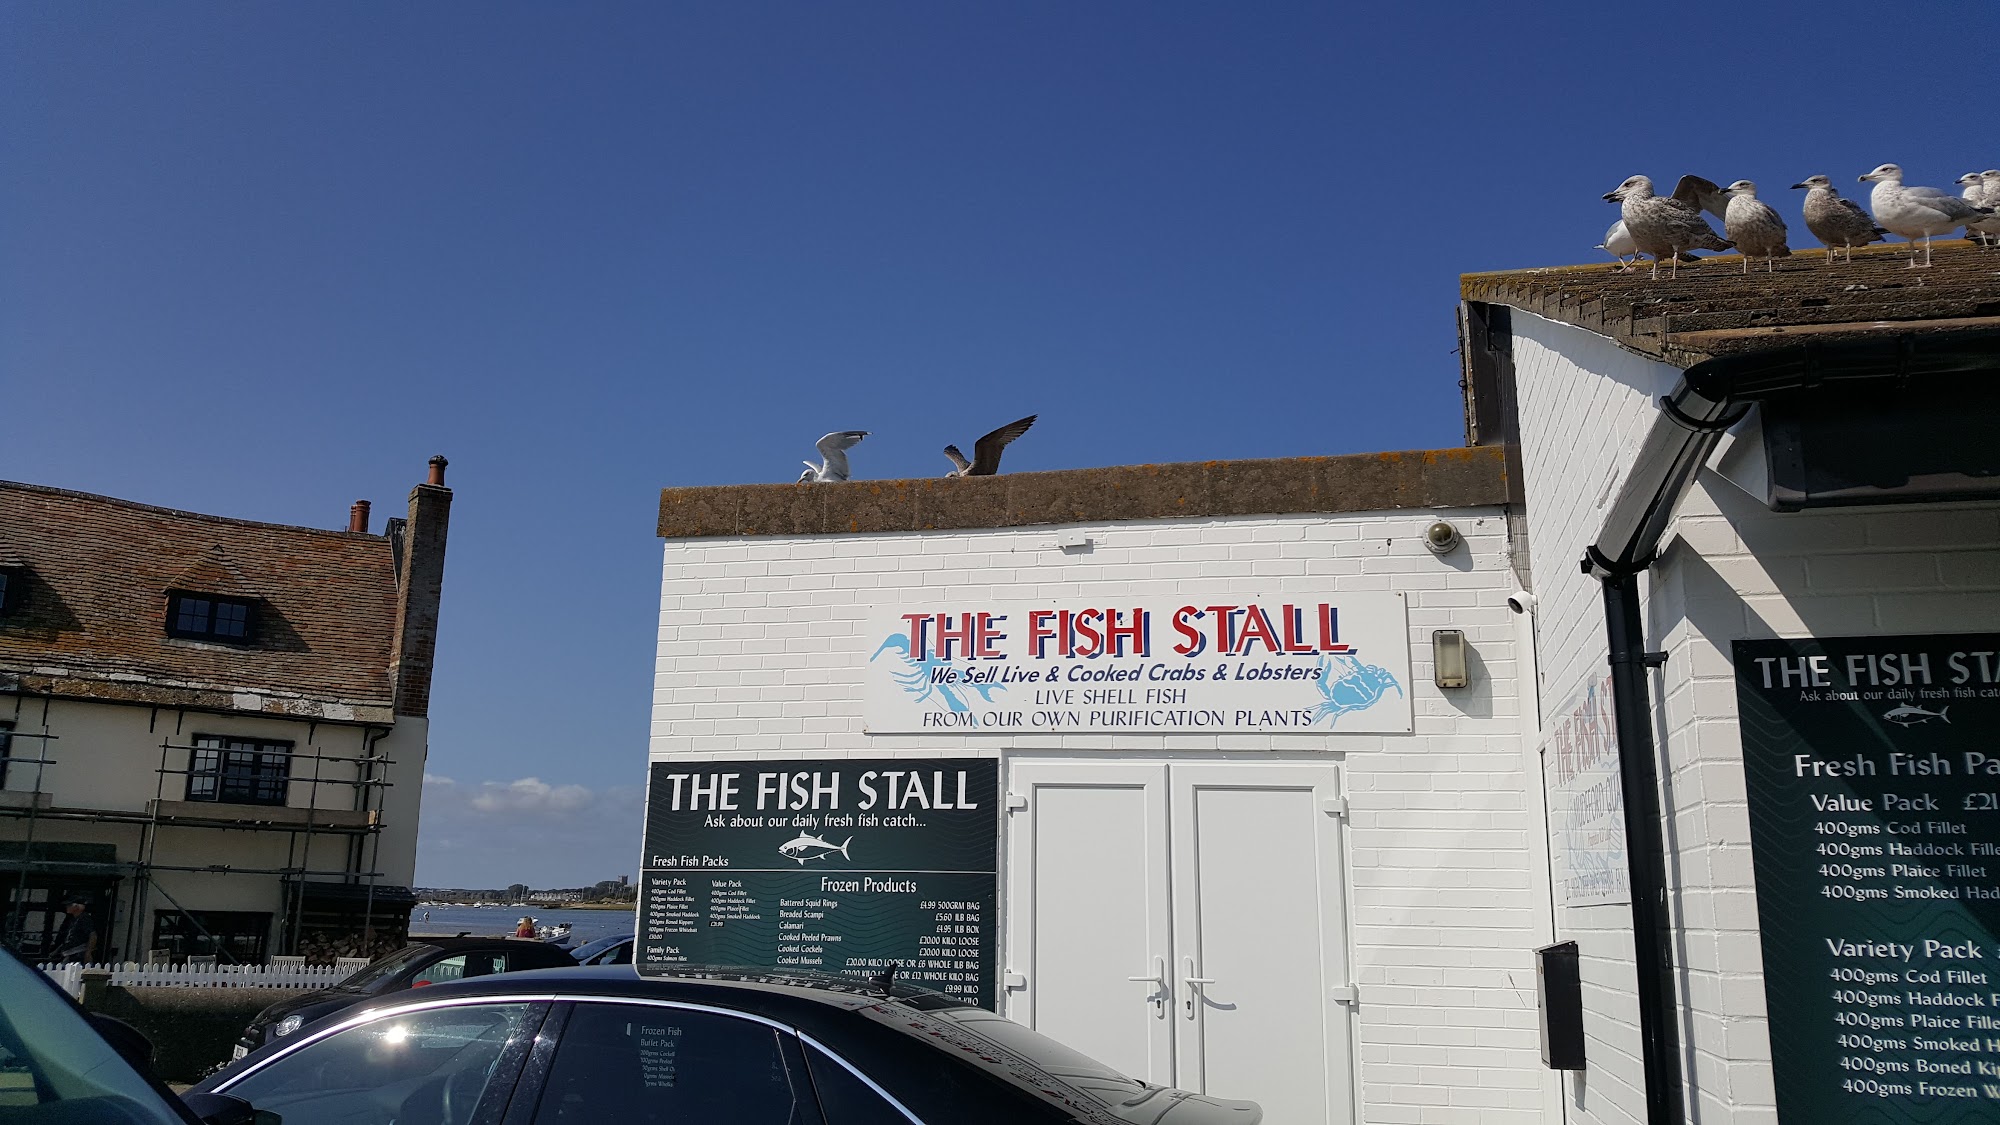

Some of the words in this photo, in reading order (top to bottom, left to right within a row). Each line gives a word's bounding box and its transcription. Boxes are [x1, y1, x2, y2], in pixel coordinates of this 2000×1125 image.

[901, 613, 1007, 661] THE
[1029, 608, 1150, 660] FISH
[1172, 603, 1358, 657] STALL
[931, 666, 957, 684] We
[962, 665, 998, 683] Sell
[1001, 665, 1039, 683] Live
[1045, 665, 1059, 682] &
[1067, 664, 1144, 683] Cooked
[1149, 663, 1206, 681] Crabs
[1213, 663, 1228, 681] &
[1235, 662, 1323, 681] Lobsters
[1753, 655, 1831, 689] THE
[1846, 652, 1932, 686] FISH
[1947, 651, 2000, 684] ST
[1036, 690, 1074, 705] LIVE
[1083, 689, 1137, 705] SHELL
[1146, 688, 1186, 704] FISH
[1800, 690, 1822, 701] Ask
[1825, 689, 1859, 701] about
[1864, 691, 1883, 701] our
[1888, 688, 1915, 702] daily
[1920, 687, 1950, 700] fresh
[1955, 687, 1976, 699] fish
[923, 711, 973, 727] FROM
[983, 711, 1022, 726] OUR
[1031, 711, 1080, 726] OWN
[1090, 710, 1225, 726] PURIFICATION
[1235, 710, 1311, 726] PLANTS
[1554, 717, 1575, 788] THE
[1794, 753, 1876, 778] Fresh
[1889, 752, 1951, 776] Fish
[1964, 751, 2000, 775] Pa
[666, 773, 740, 811] THE
[756, 771, 840, 811] FISH
[858, 770, 978, 810] STALL
[1810, 793, 1873, 812] Value
[1883, 793, 1939, 811] Pack
[704, 814, 728, 828] Ask
[730, 814, 765, 827] about
[767, 816, 788, 827] our
[792, 814, 819, 830] daily
[823, 813, 853, 827] fresh
[858, 813, 878, 827] fish
[1814, 822, 1881, 838] 400gms
[1886, 821, 1921, 835] Cod
[1928, 821, 1968, 835] Fillet
[1816, 843, 1883, 859] 400gms
[1888, 842, 1964, 856] Haddock
[653, 855, 677, 867] Fresh
[680, 855, 699, 867] Fish
[702, 855, 729, 867] Packs
[1818, 863, 1886, 880] 400gms
[1890, 863, 1941, 878] Plaice
[1947, 864, 1987, 878] Fillet
[651, 878, 671, 887] Variety
[673, 878, 687, 886] Pack
[711, 880, 727, 888] Value
[728, 880, 742, 888] Pack
[821, 876, 859, 892] Frozen
[864, 877, 917, 893] Products
[1821, 885, 1888, 901] 400gms
[1894, 885, 1960, 899] Smoked
[780, 899, 804, 907] Battered
[805, 899, 821, 909] Squid
[822, 900, 838, 909] Rings
[920, 901, 936, 910] £4.99
[938, 901, 965, 910] 500GRM
[966, 901, 980, 911] BAG
[804, 911, 824, 920] Scampi
[966, 913, 980, 922] BAG
[779, 921, 804, 930] Calamari
[936, 924, 952, 933] £4.95
[966, 925, 980, 934] BOX
[778, 933, 800, 941] Cooked
[801, 933, 820, 942] Peeled
[821, 934, 842, 942] Prawns
[919, 936, 940, 945] £20.00
[942, 936, 957, 945] KILO
[958, 937, 979, 946] LOOSE
[647, 946, 665, 955] Family
[666, 946, 680, 954] Pack
[777, 944, 799, 953] Cooked
[919, 948, 940, 957] £20.00
[942, 948, 957, 957] KILO
[958, 949, 979, 958] LOOSE
[1825, 938, 1914, 963] Variety
[1925, 939, 1983, 959] Pack
[777, 956, 799, 964] Cooked
[800, 956, 823, 965] Mussels
[846, 957, 866, 967] £20.00
[868, 958, 882, 967] KILO
[906, 959, 917, 968] OR
[918, 959, 926, 968] £6
[928, 960, 951, 969] WHOLE
[965, 961, 979, 970] BAG
[900, 971, 910, 980] OR
[911, 971, 922, 980] £12
[923, 972, 947, 981] WHOLE
[948, 972, 963, 981] KILO
[965, 973, 979, 982] BAG
[1830, 968, 1899, 985] 400gms
[1905, 969, 1941, 984] Cod
[1947, 970, 1988, 984] Fillet
[945, 984, 962, 993] £9.99
[963, 985, 979, 994] KILO
[1832, 990, 1902, 1007] 400gms
[1908, 991, 1985, 1007] Haddock
[1835, 1012, 1904, 1030] 400gms
[1911, 1014, 1961, 1029] Plaice
[641, 1025, 665, 1036] Frozen
[667, 1026, 682, 1036] Fish
[660, 1039, 675, 1048] Pack
[1837, 1034, 1907, 1052] 400gms
[1913, 1036, 1981, 1051] Smoked
[1840, 1056, 1910, 1075] 400gms
[1916, 1058, 1971, 1074] Boned
[1842, 1079, 1913, 1098] 400gms
[1919, 1081, 1978, 1098] Frozen
